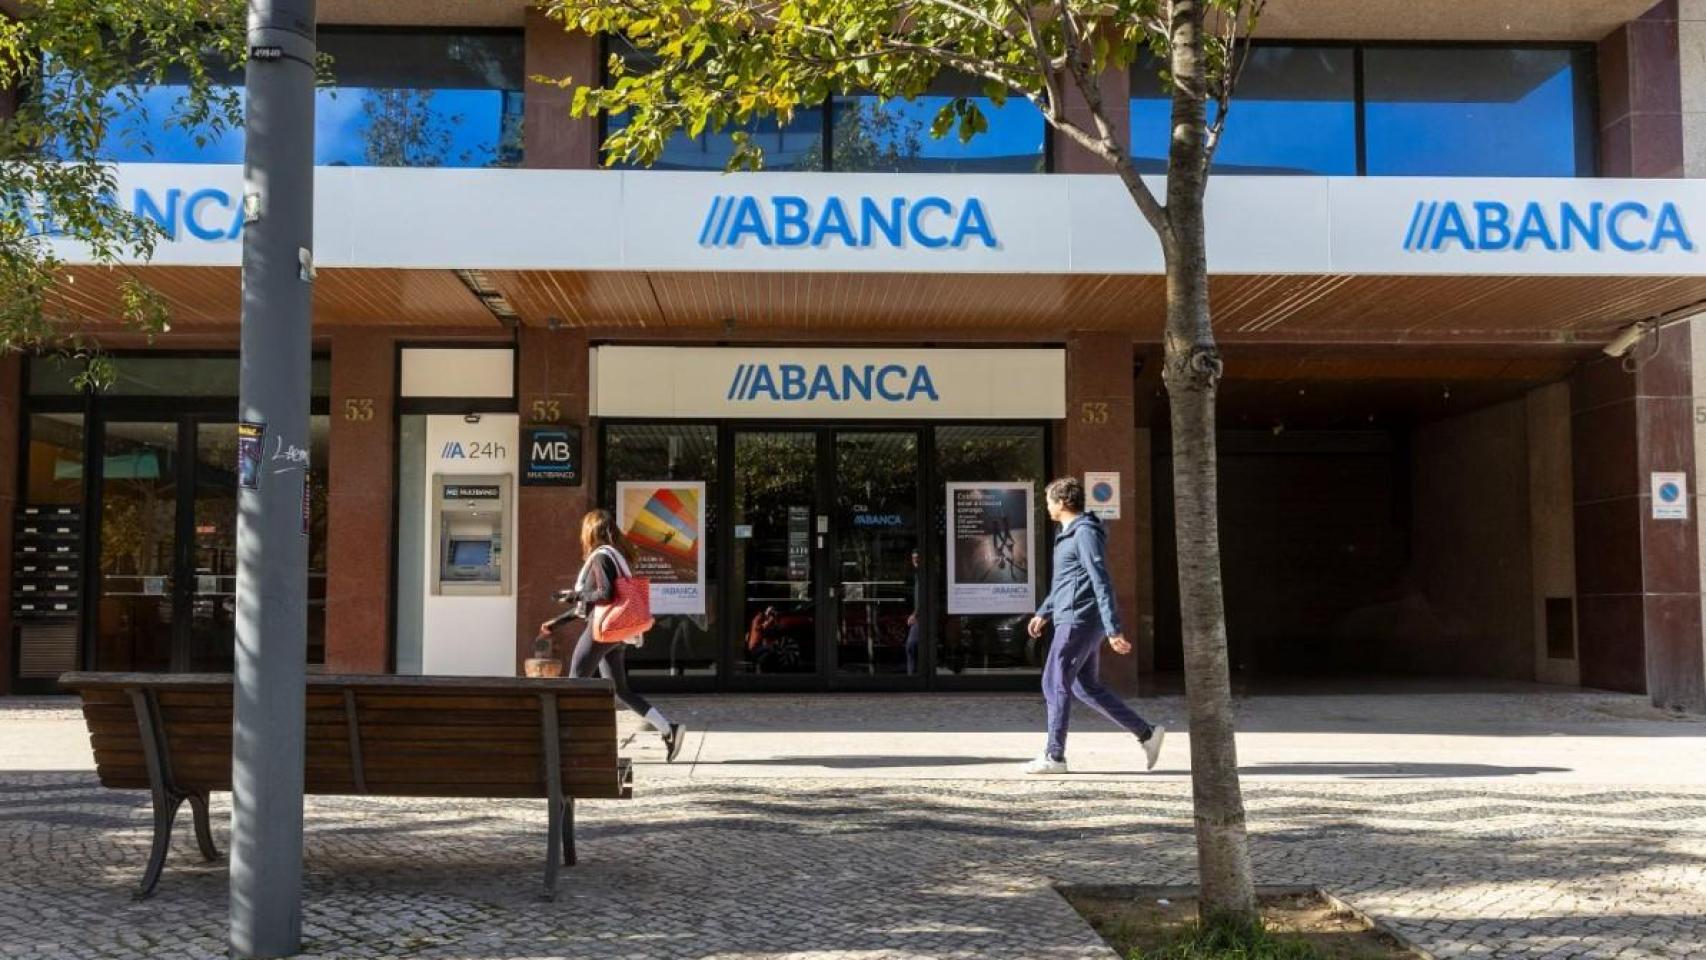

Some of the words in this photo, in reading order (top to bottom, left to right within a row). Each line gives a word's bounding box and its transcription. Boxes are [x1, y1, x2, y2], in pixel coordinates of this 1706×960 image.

[345, 399, 374, 420] 53
[532, 401, 560, 422] 53
[1081, 402, 1109, 424] 53
[469, 442, 506, 459] 24h
[531, 441, 571, 462] MB
[527, 471, 575, 480] MULTIBANCO
